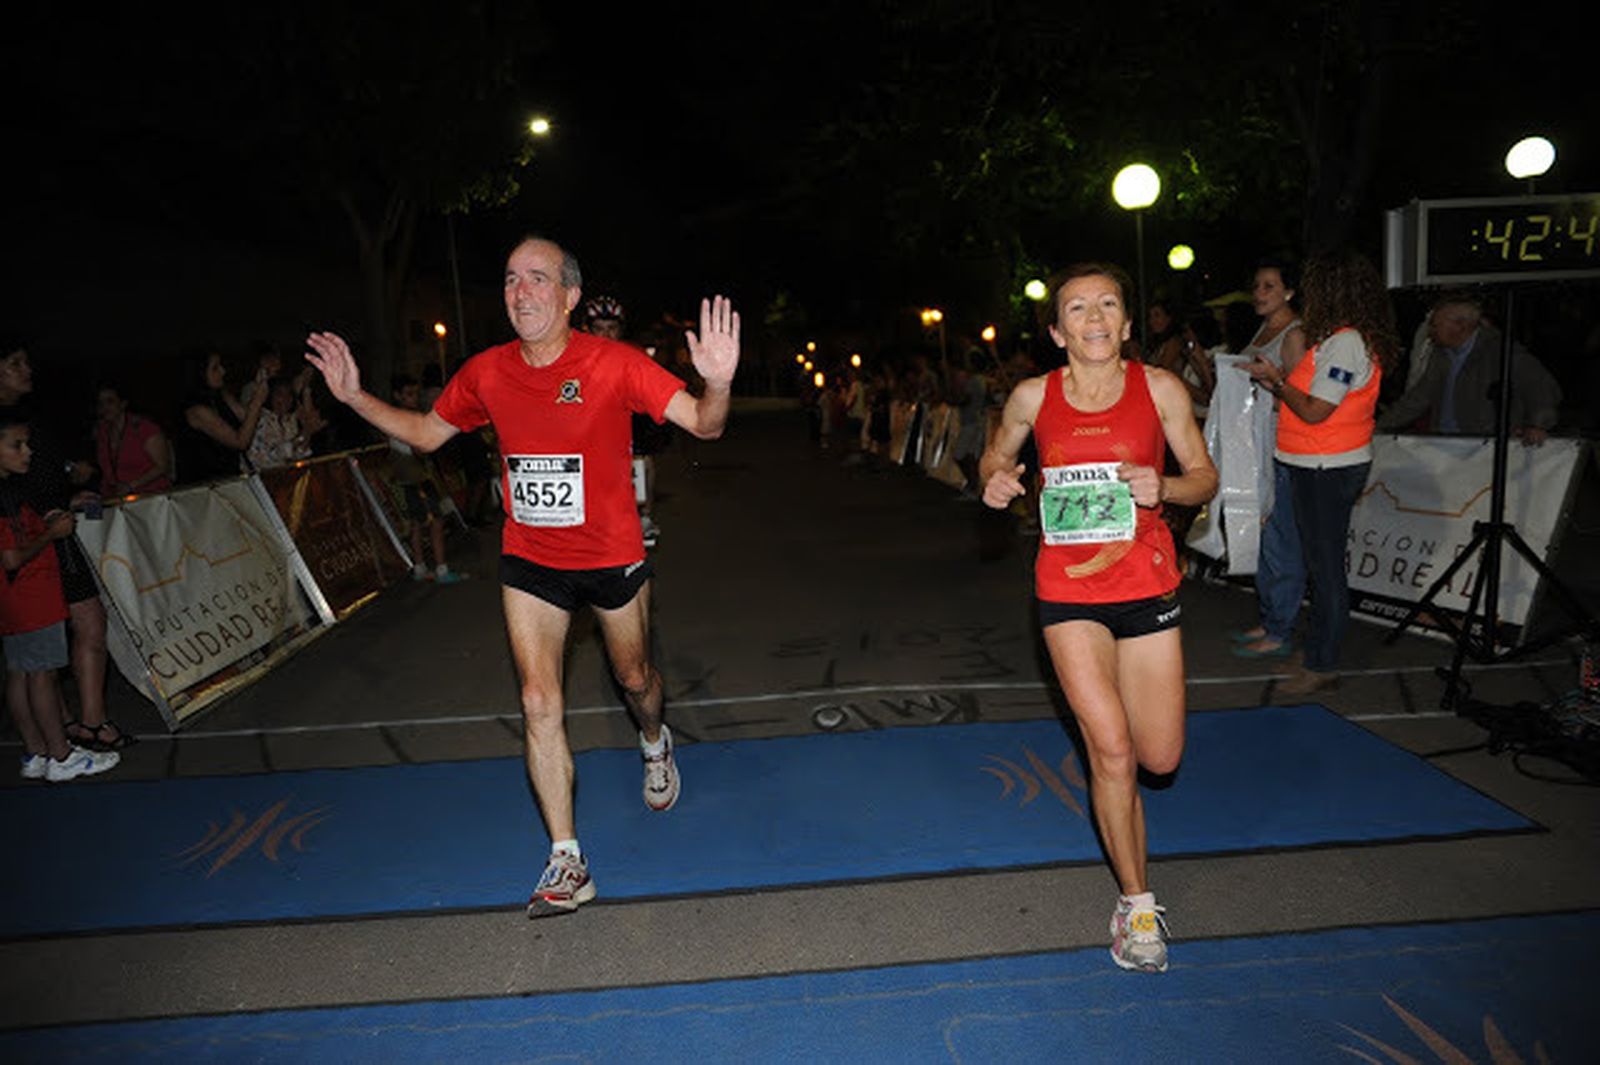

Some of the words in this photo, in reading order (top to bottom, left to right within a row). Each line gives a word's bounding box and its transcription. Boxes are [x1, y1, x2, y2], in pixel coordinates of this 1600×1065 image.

[514, 481, 573, 508] 4552
[130, 579, 262, 649] DIPUTACION
[148, 614, 254, 680] CIUDAD
